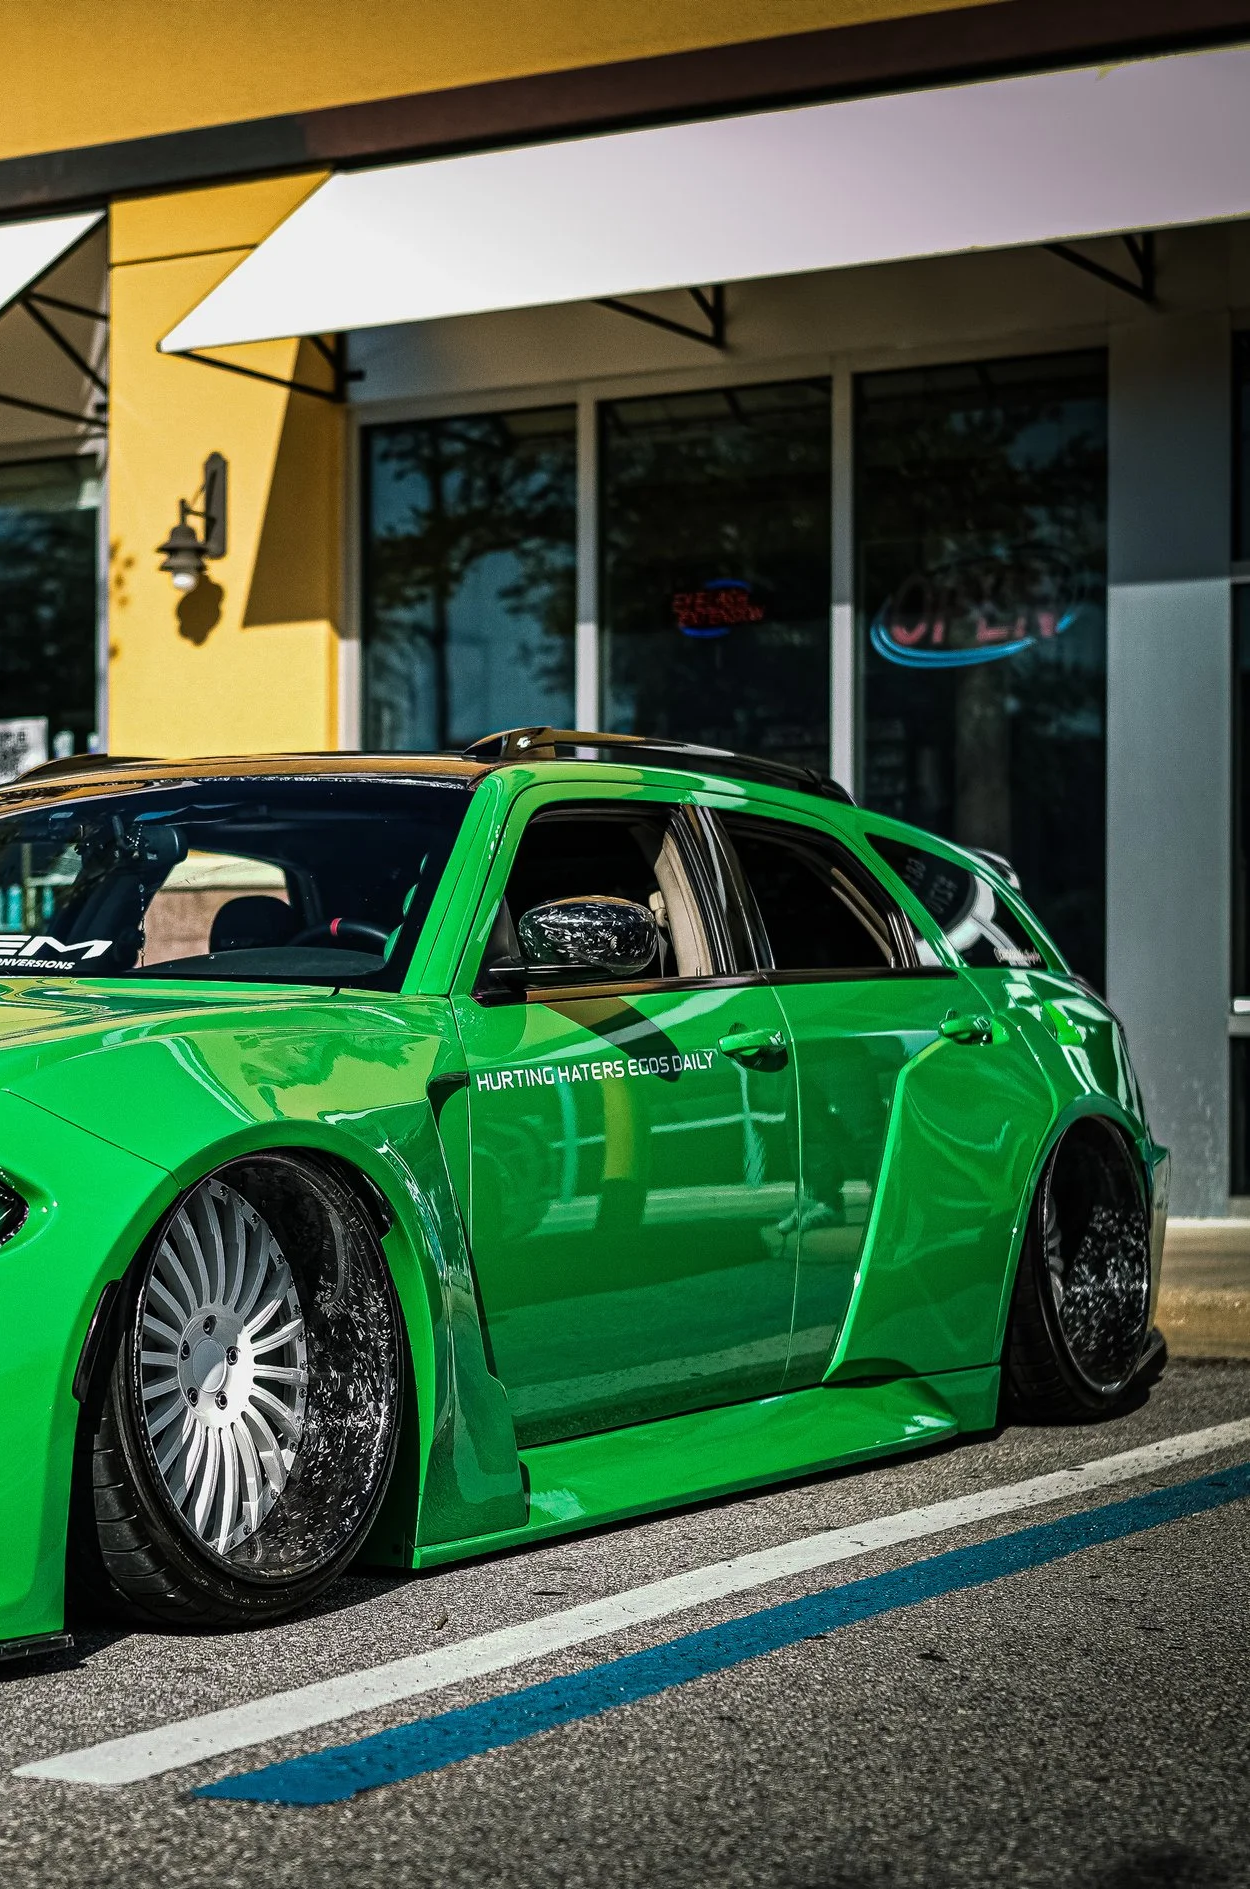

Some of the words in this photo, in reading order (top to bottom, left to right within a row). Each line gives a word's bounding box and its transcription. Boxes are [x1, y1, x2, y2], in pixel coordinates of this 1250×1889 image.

[475, 1066, 555, 1092] HURTING
[557, 1060, 625, 1083] HATERS
[627, 1055, 670, 1076] EGOS
[672, 1051, 715, 1072] DAILY
